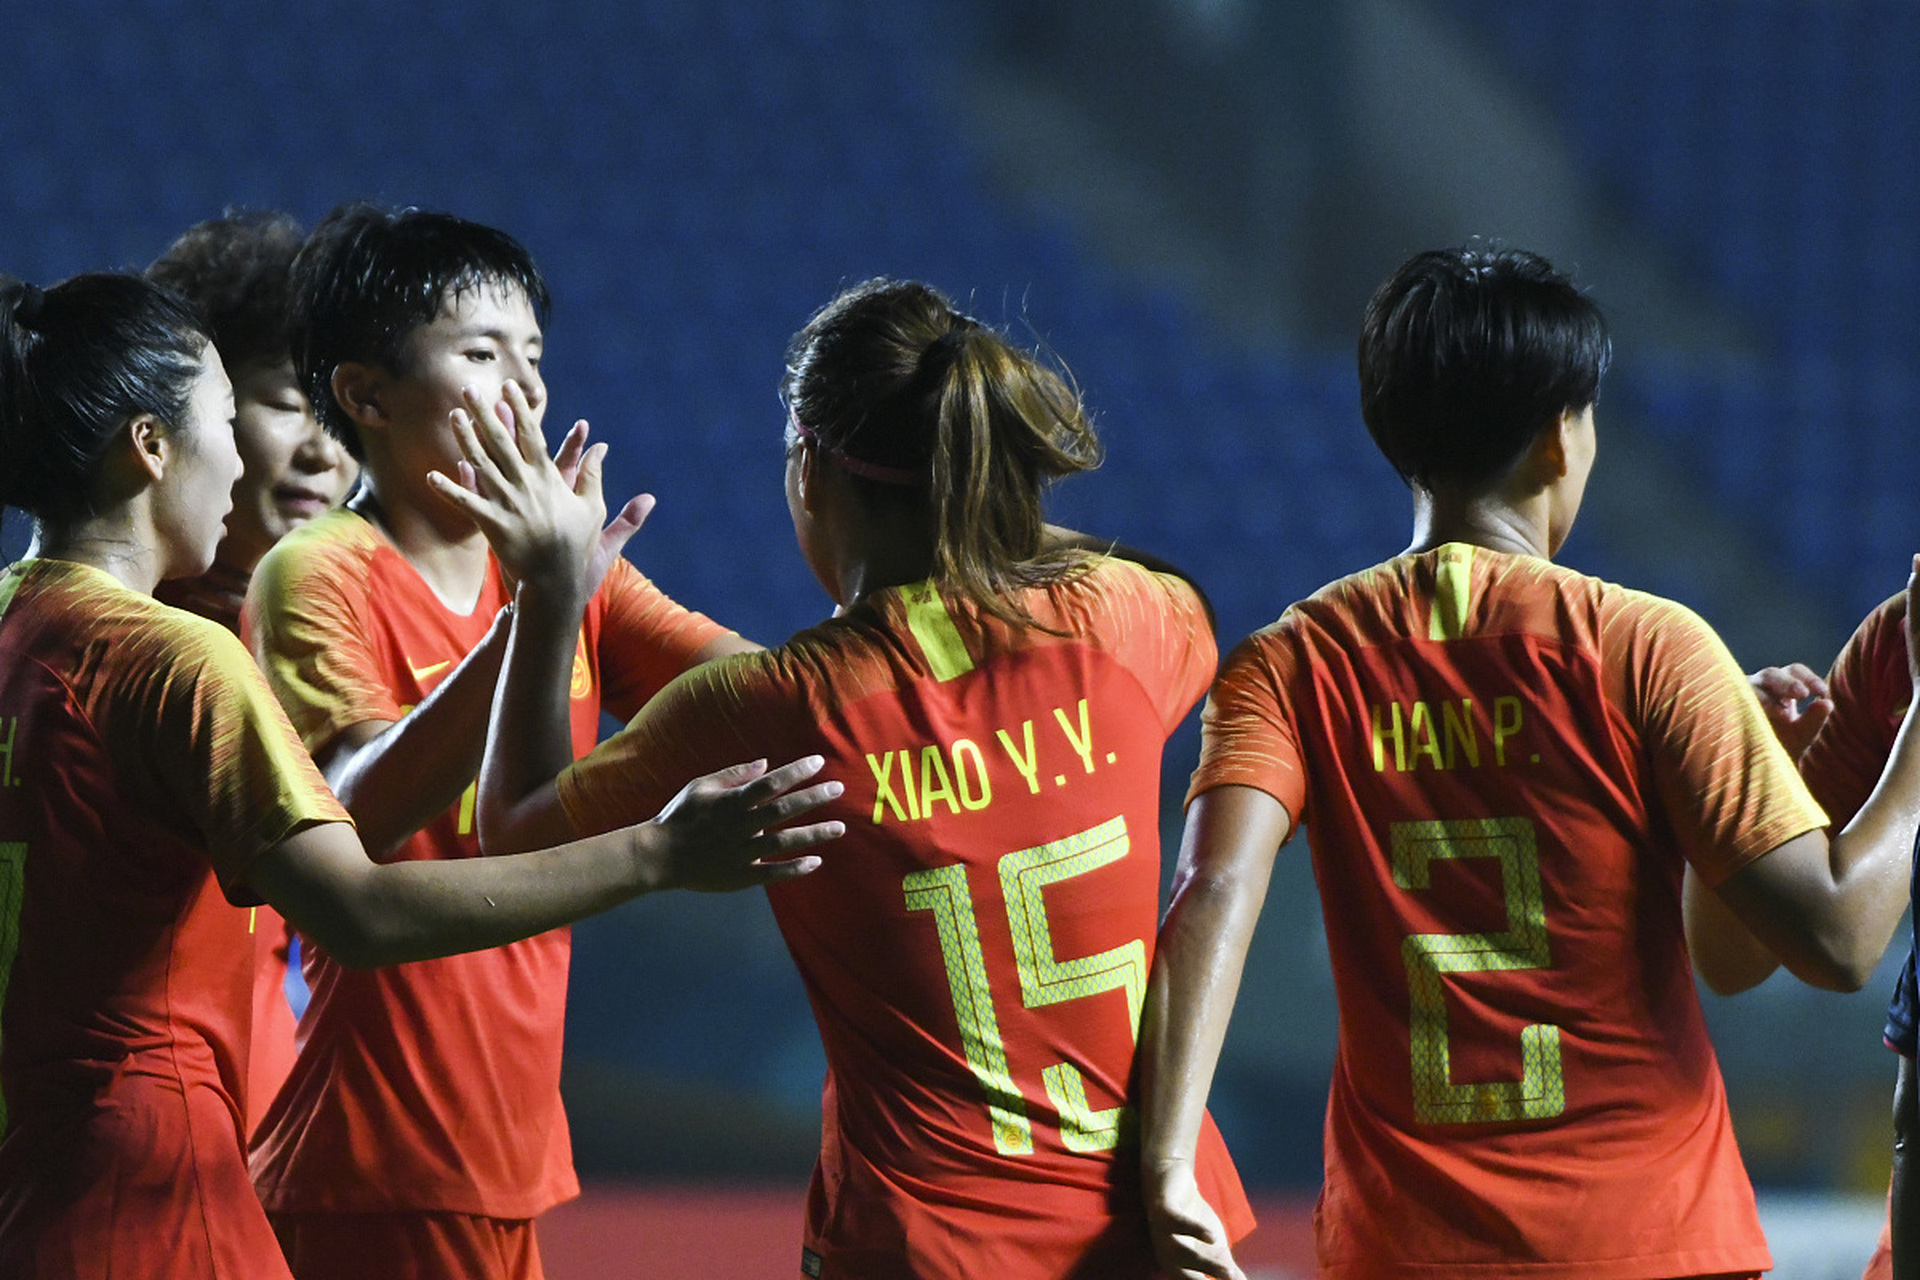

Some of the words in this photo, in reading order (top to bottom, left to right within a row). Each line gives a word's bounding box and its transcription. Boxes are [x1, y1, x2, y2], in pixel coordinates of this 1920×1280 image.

[866, 739, 991, 824] XIAO
[1373, 699, 1479, 772] HAN
[1494, 696, 1540, 766] P.
[903, 815, 1146, 1156] 15
[1389, 816, 1565, 1124] 2
